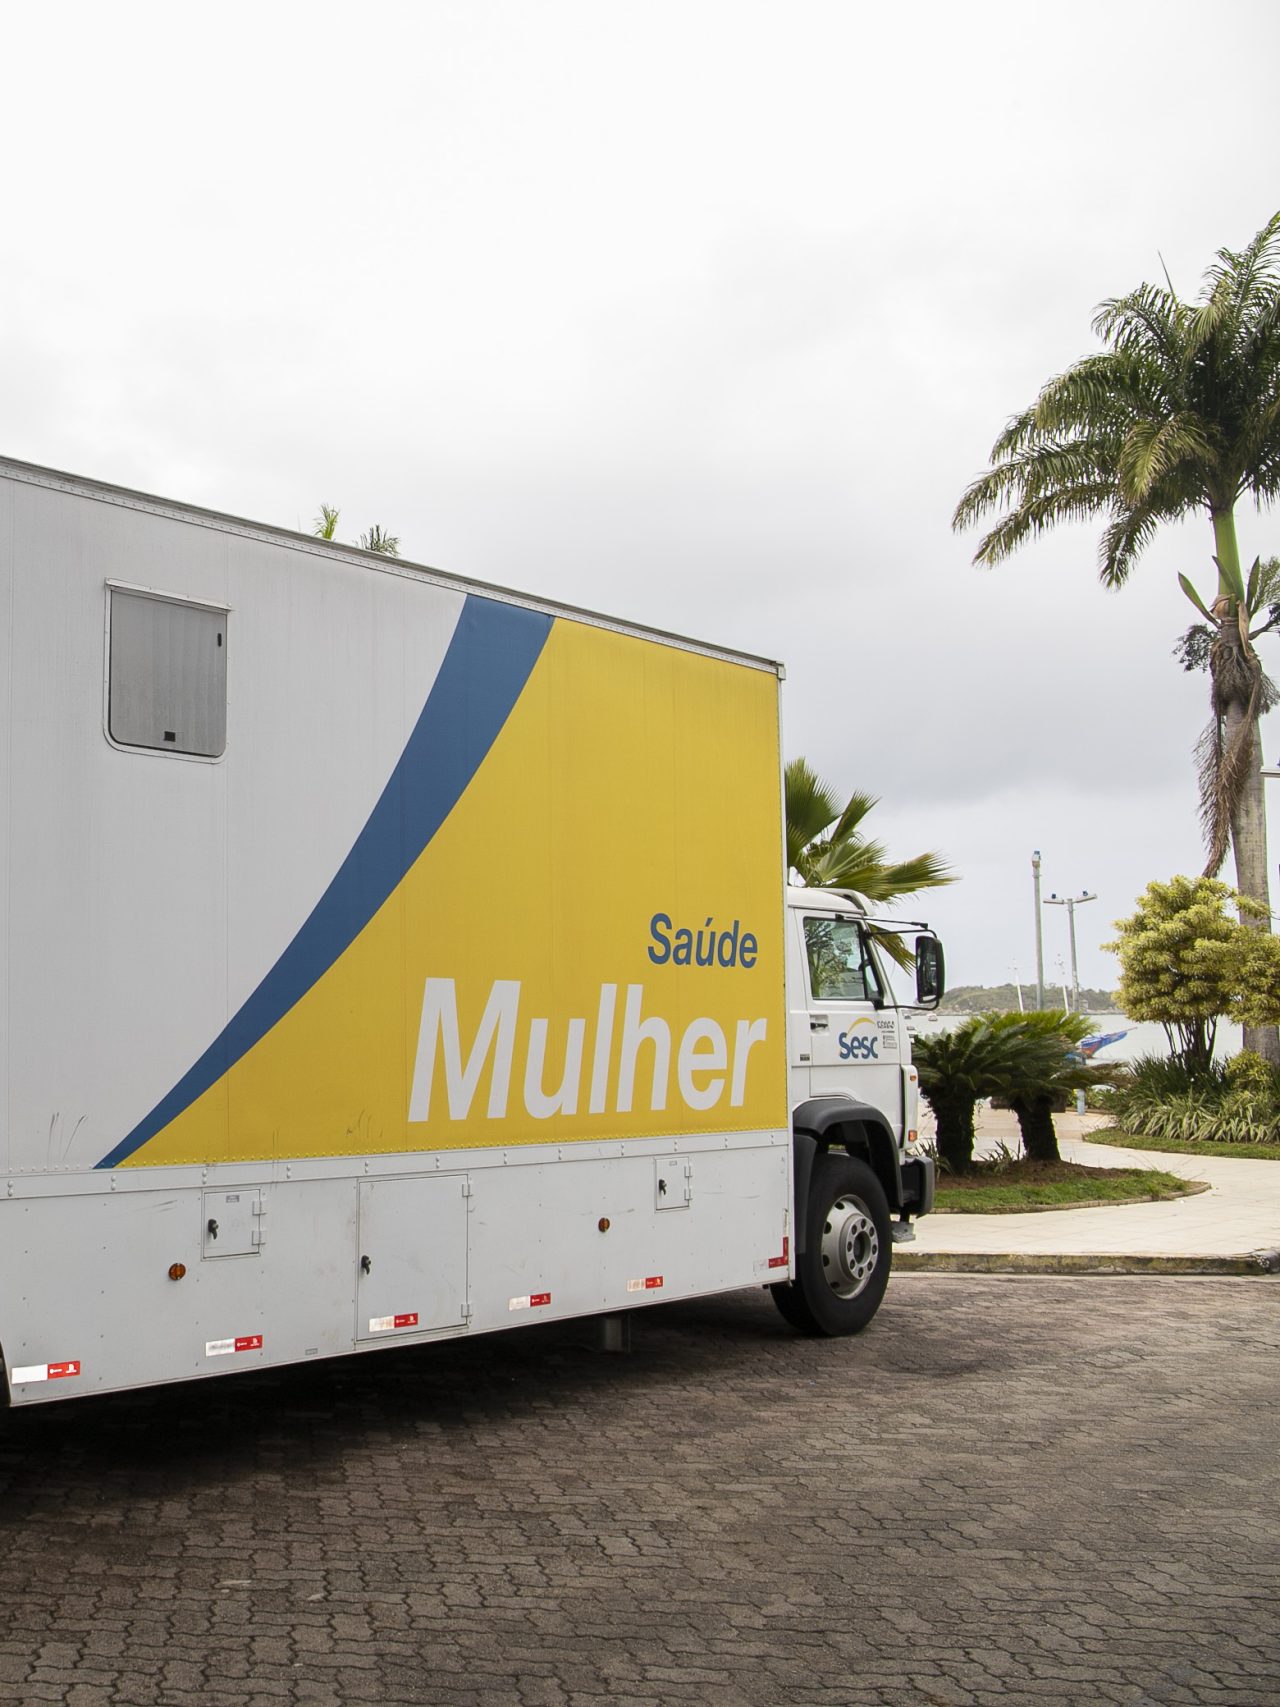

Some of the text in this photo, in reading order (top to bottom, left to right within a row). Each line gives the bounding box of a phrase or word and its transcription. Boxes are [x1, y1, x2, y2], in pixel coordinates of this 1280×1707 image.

[648, 913, 759, 968] Saúde
[408, 977, 767, 1122] Mulher
[839, 1032, 878, 1059] Sesc
